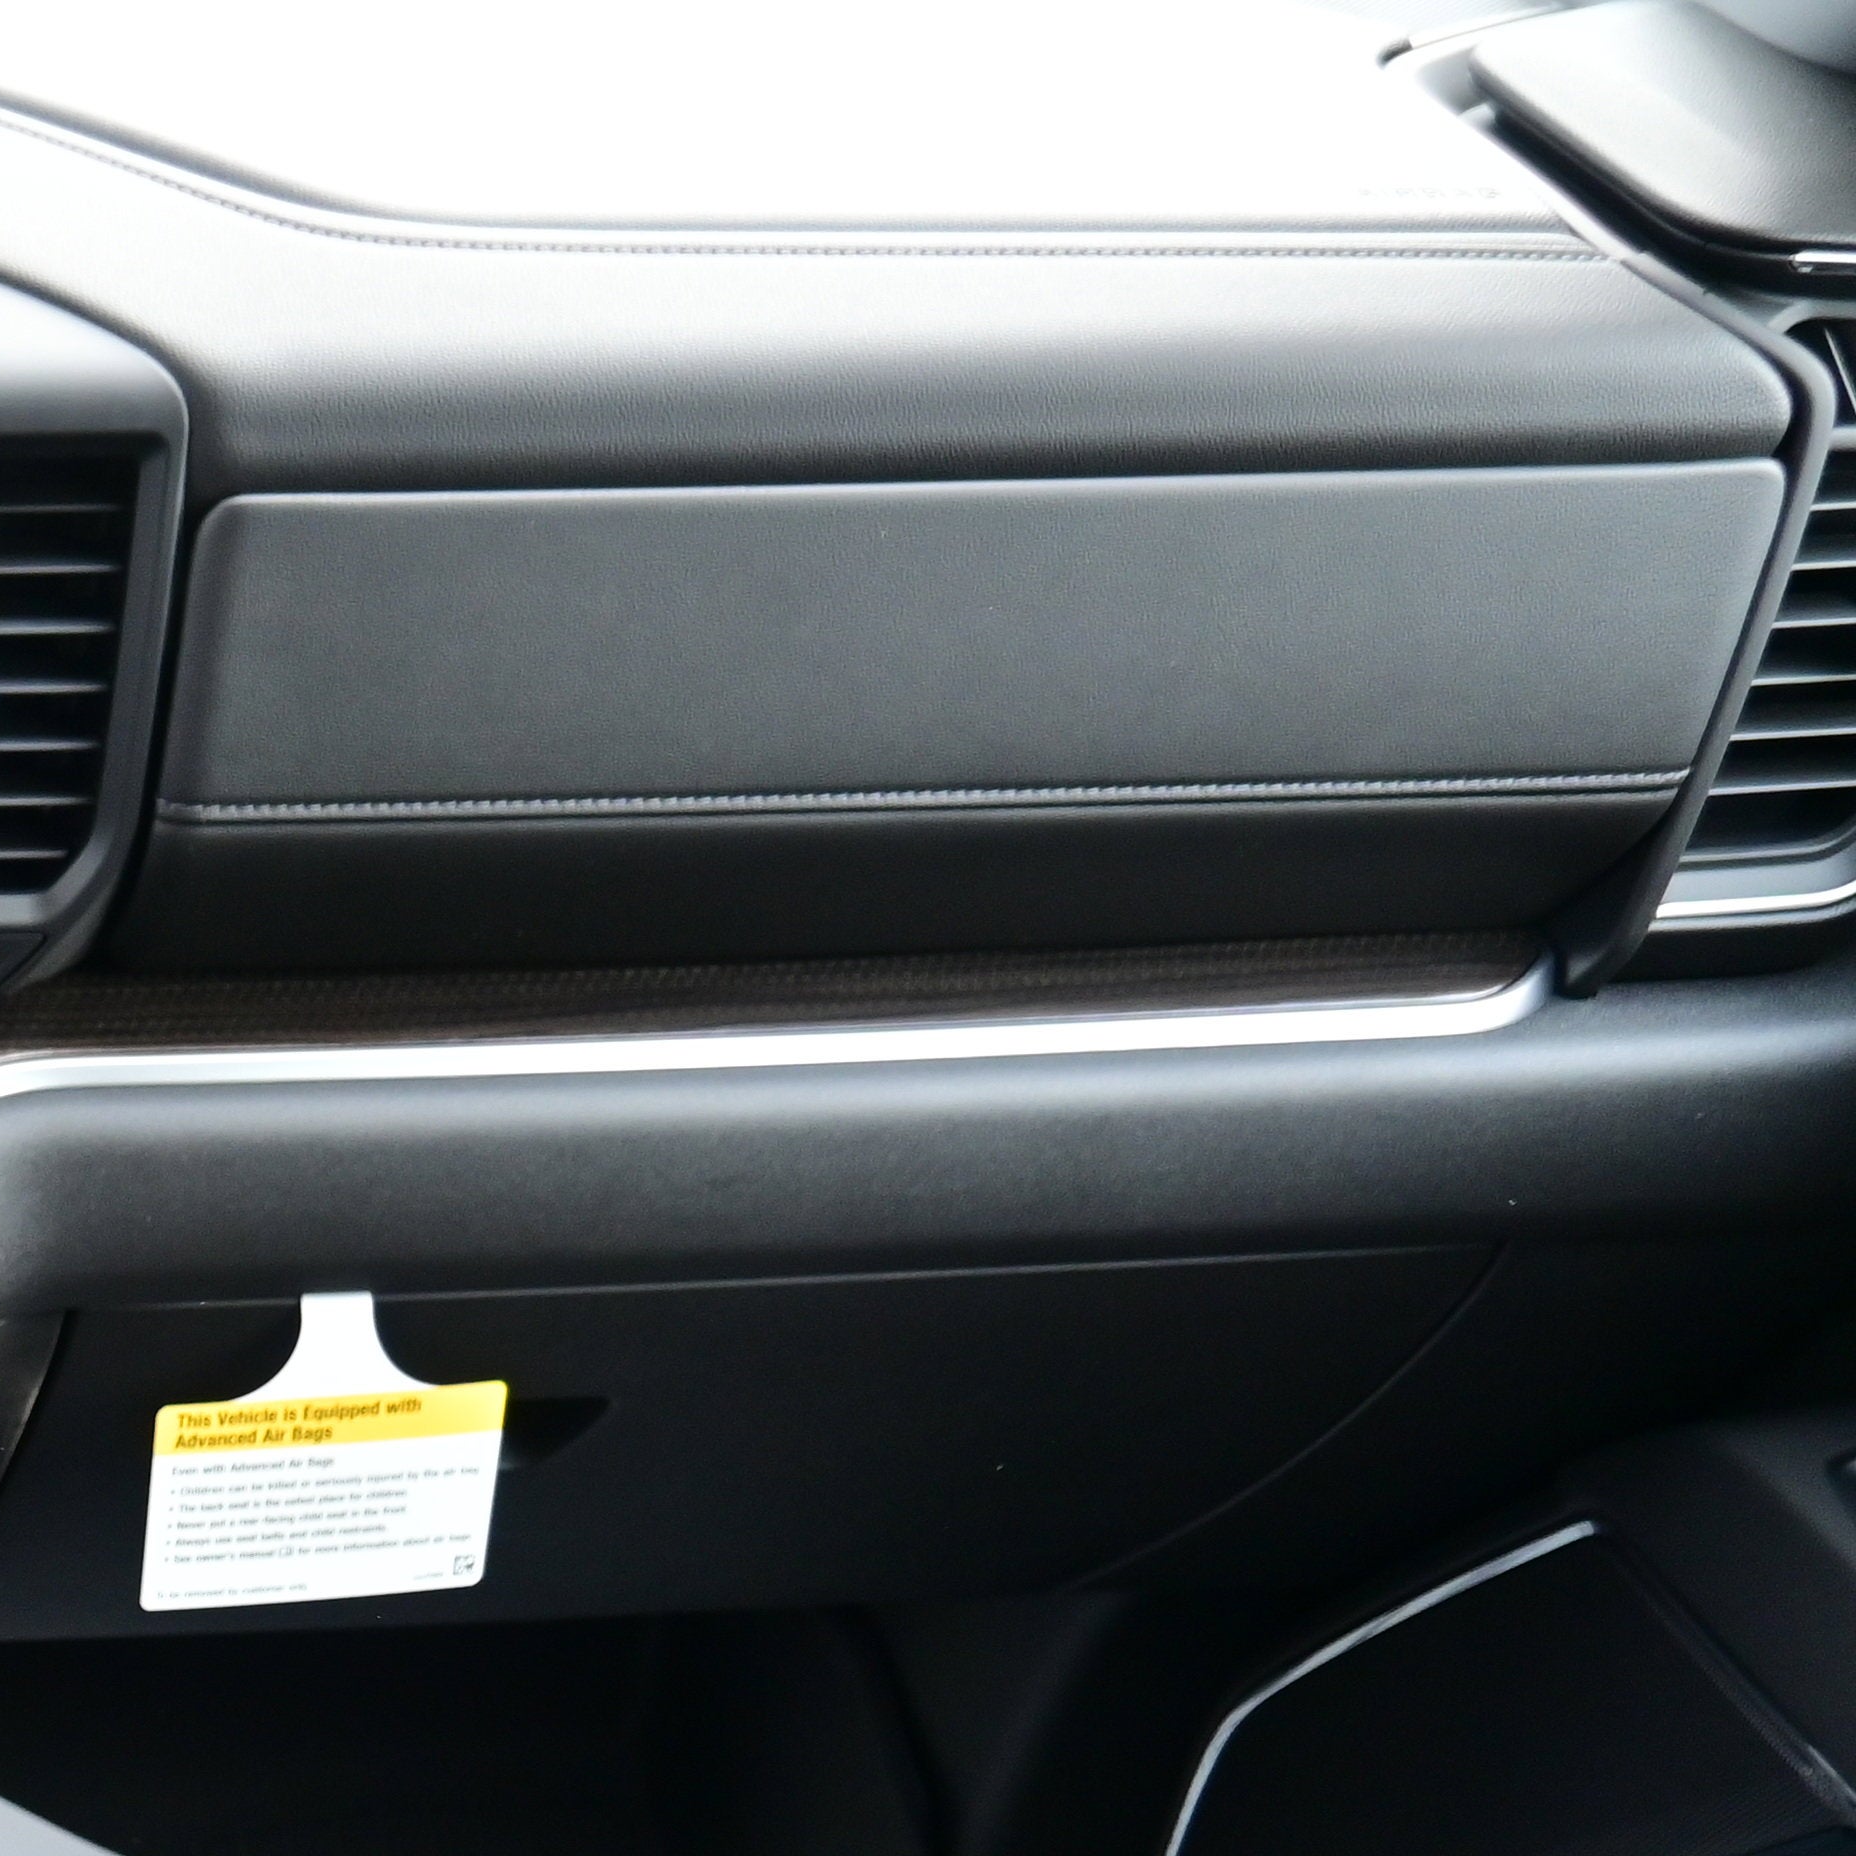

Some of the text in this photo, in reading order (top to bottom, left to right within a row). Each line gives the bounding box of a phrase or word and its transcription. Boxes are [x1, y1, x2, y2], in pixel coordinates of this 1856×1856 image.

[177, 1399, 423, 1429] This Vehicle is Equipped with
[175, 1424, 334, 1449] Advanced Air Bags
